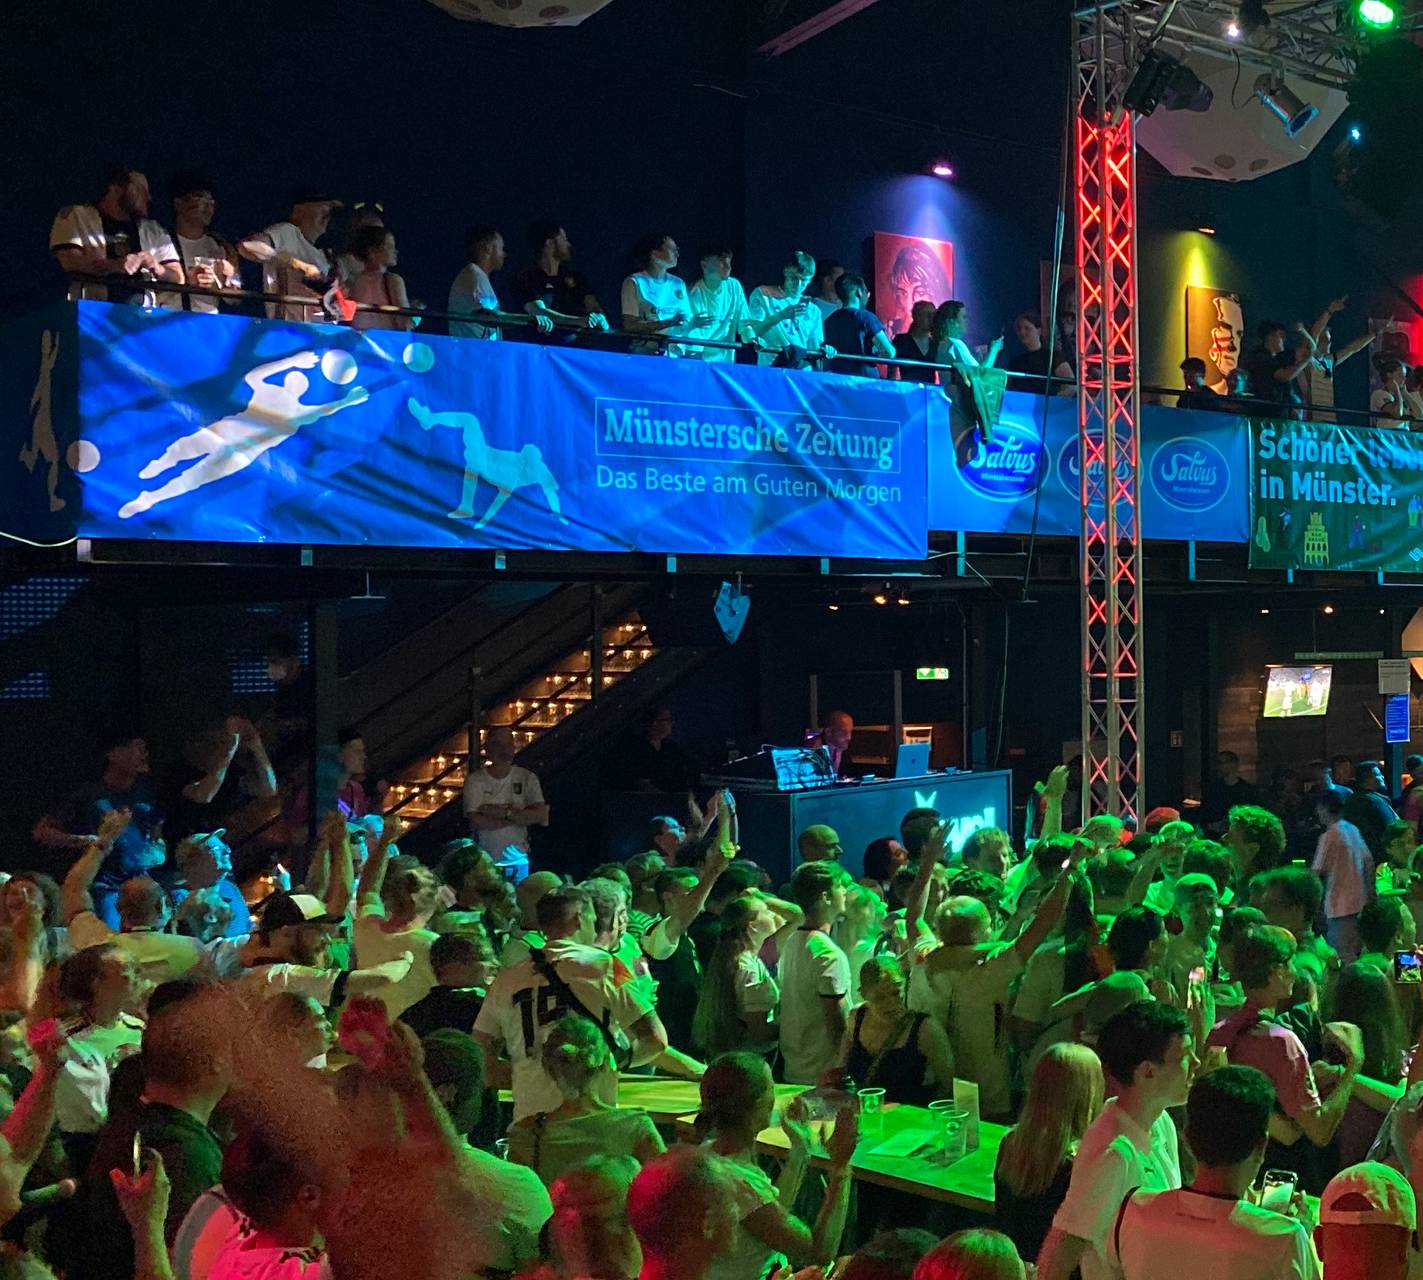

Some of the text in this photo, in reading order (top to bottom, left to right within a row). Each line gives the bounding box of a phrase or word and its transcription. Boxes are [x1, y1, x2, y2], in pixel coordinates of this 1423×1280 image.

[604, 407, 894, 470] Münstersche Zeitung
[1259, 428, 1362, 467] Schöner
[596, 464, 902, 506] Das Beste am Guten Morgen
[1161, 450, 1218, 485] Salvus
[1260, 468, 1397, 507] in Münster.
